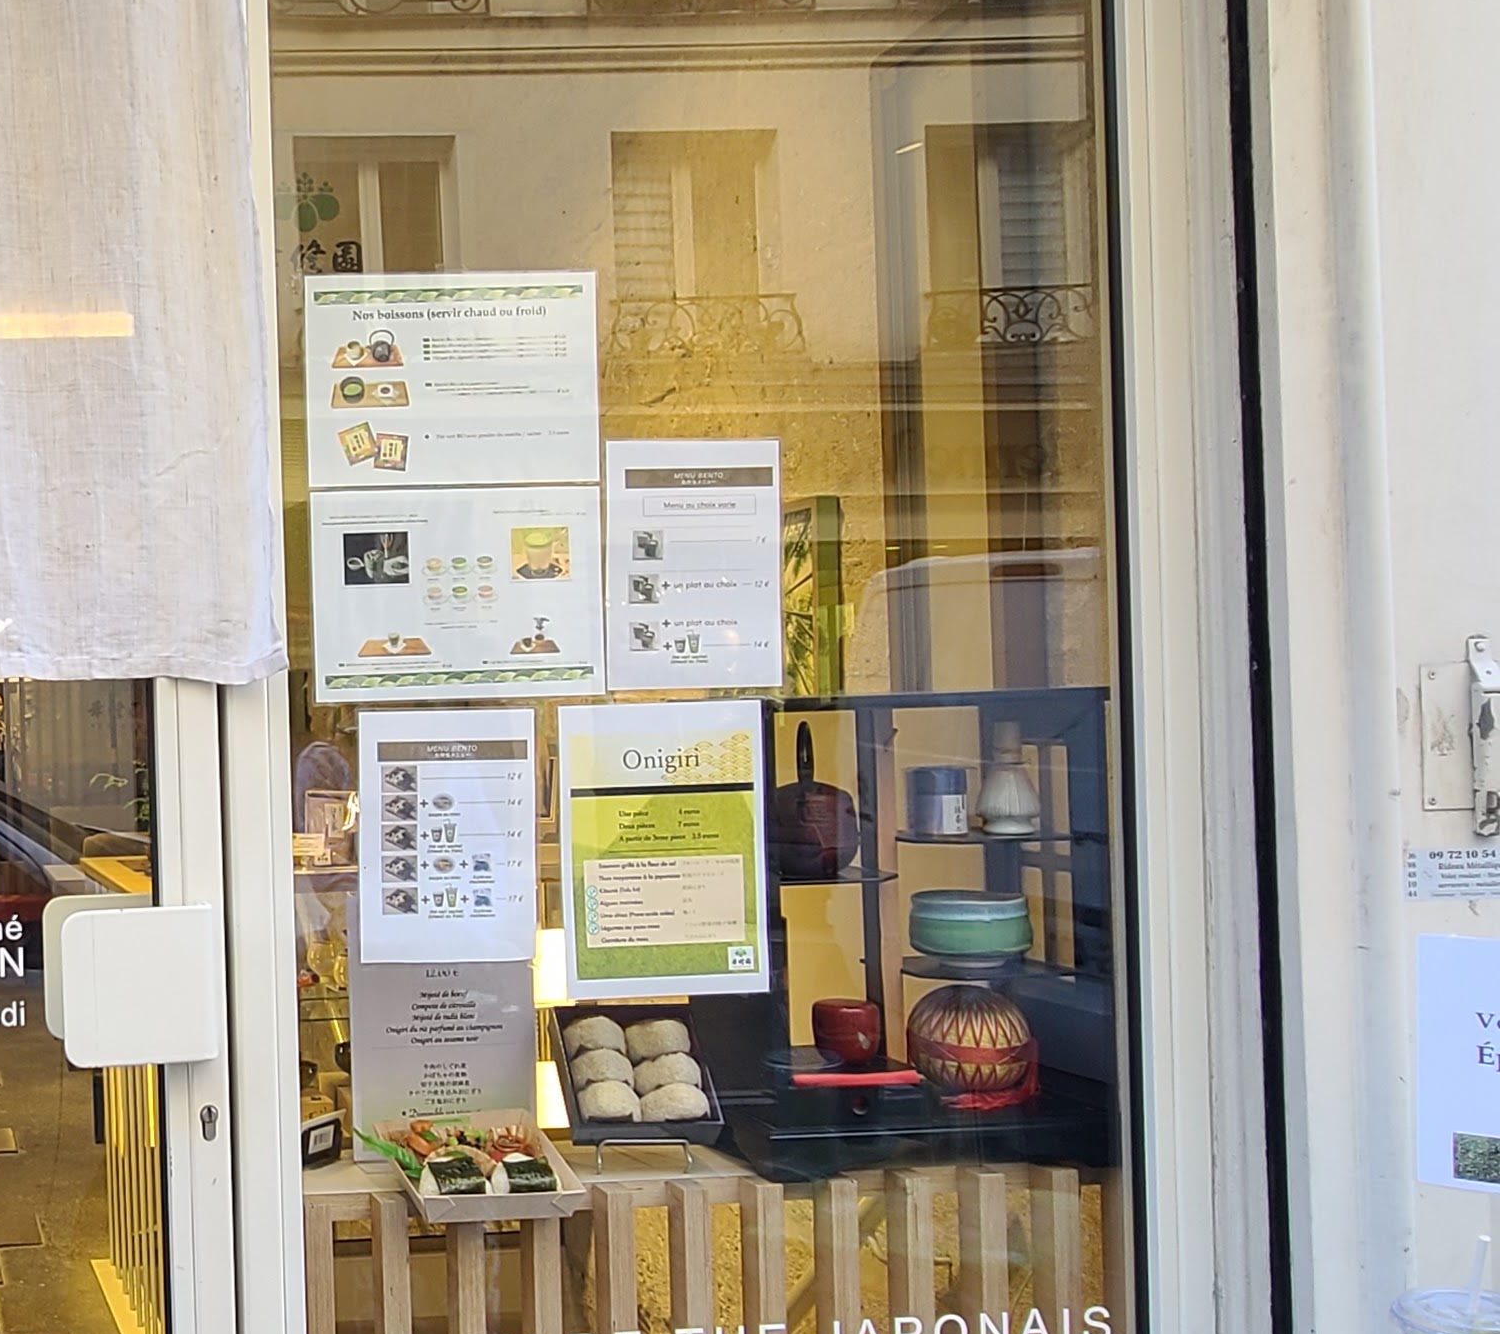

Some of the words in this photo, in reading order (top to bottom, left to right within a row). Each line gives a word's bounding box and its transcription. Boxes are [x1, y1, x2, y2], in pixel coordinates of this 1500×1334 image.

[352, 310, 374, 321] Nos
[377, 309, 424, 320] boissons
[427, 307, 462, 321] (servir
[464, 306, 496, 318] chaud
[500, 308, 513, 316] ou
[515, 305, 547, 318] froid)
[698, 471, 724, 479] BENTO
[686, 581, 701, 589] plat
[622, 748, 701, 773] Onigiri
[1429, 851, 1443, 859] 09
[1447, 850, 1462, 859] 72
[1465, 850, 1478, 858] 10
[1482, 849, 1496, 858] 54
